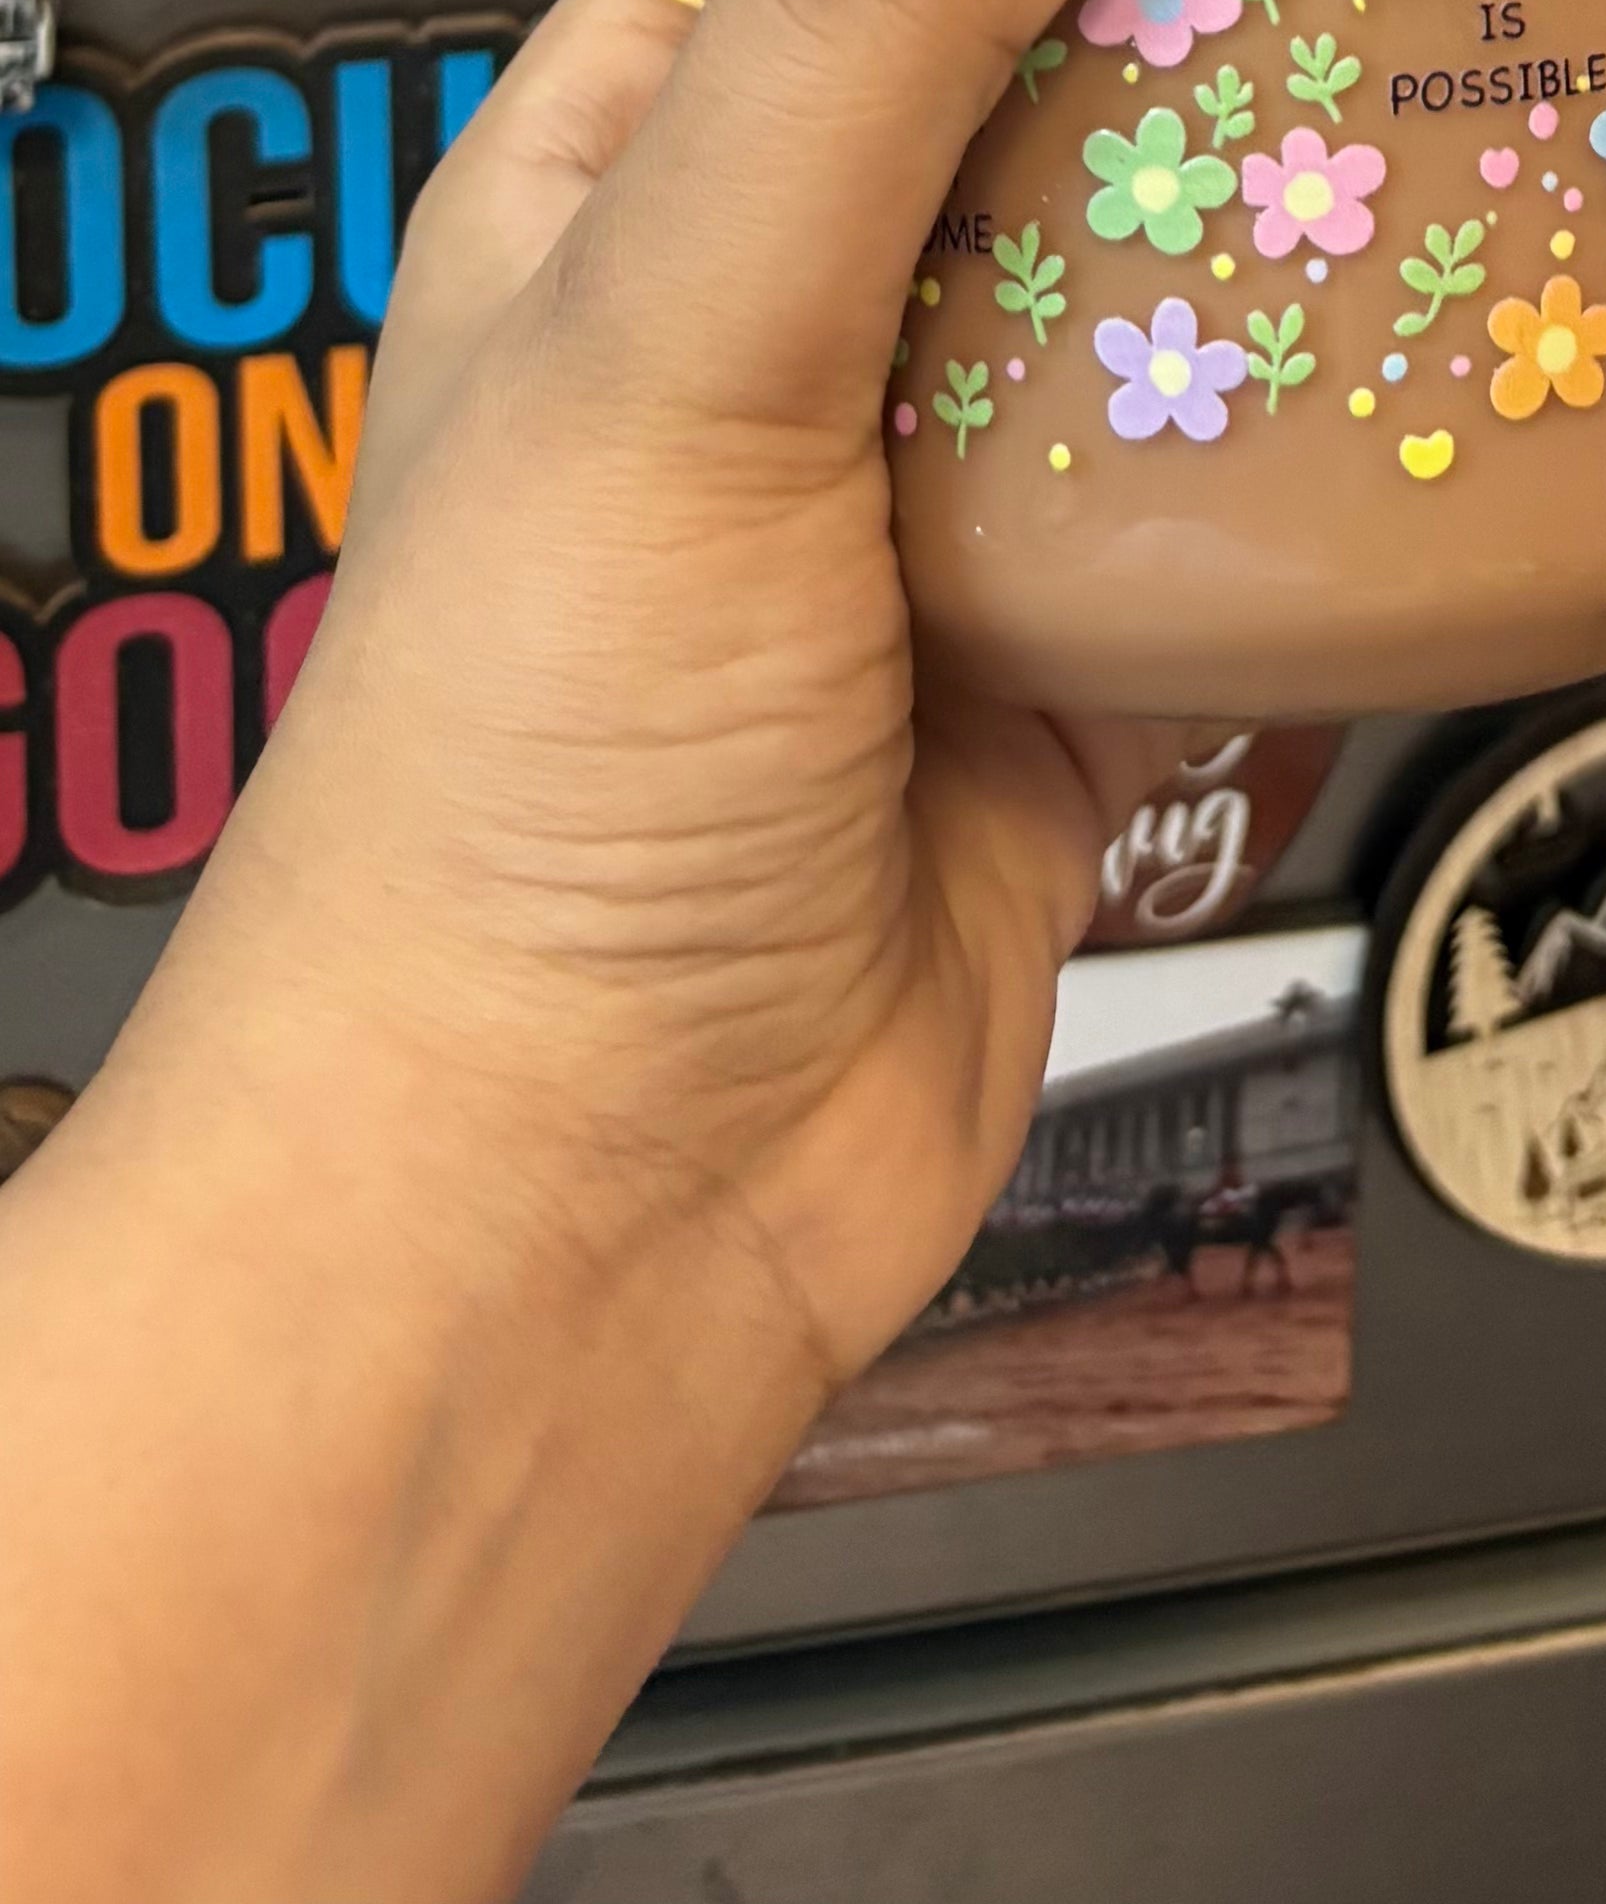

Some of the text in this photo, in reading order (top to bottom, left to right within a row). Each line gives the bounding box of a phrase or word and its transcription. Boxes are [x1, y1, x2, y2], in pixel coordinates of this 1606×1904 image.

[1480, 2, 1527, 42] IS
[0, 51, 497, 372] OCU
[95, 342, 370, 577] ON
